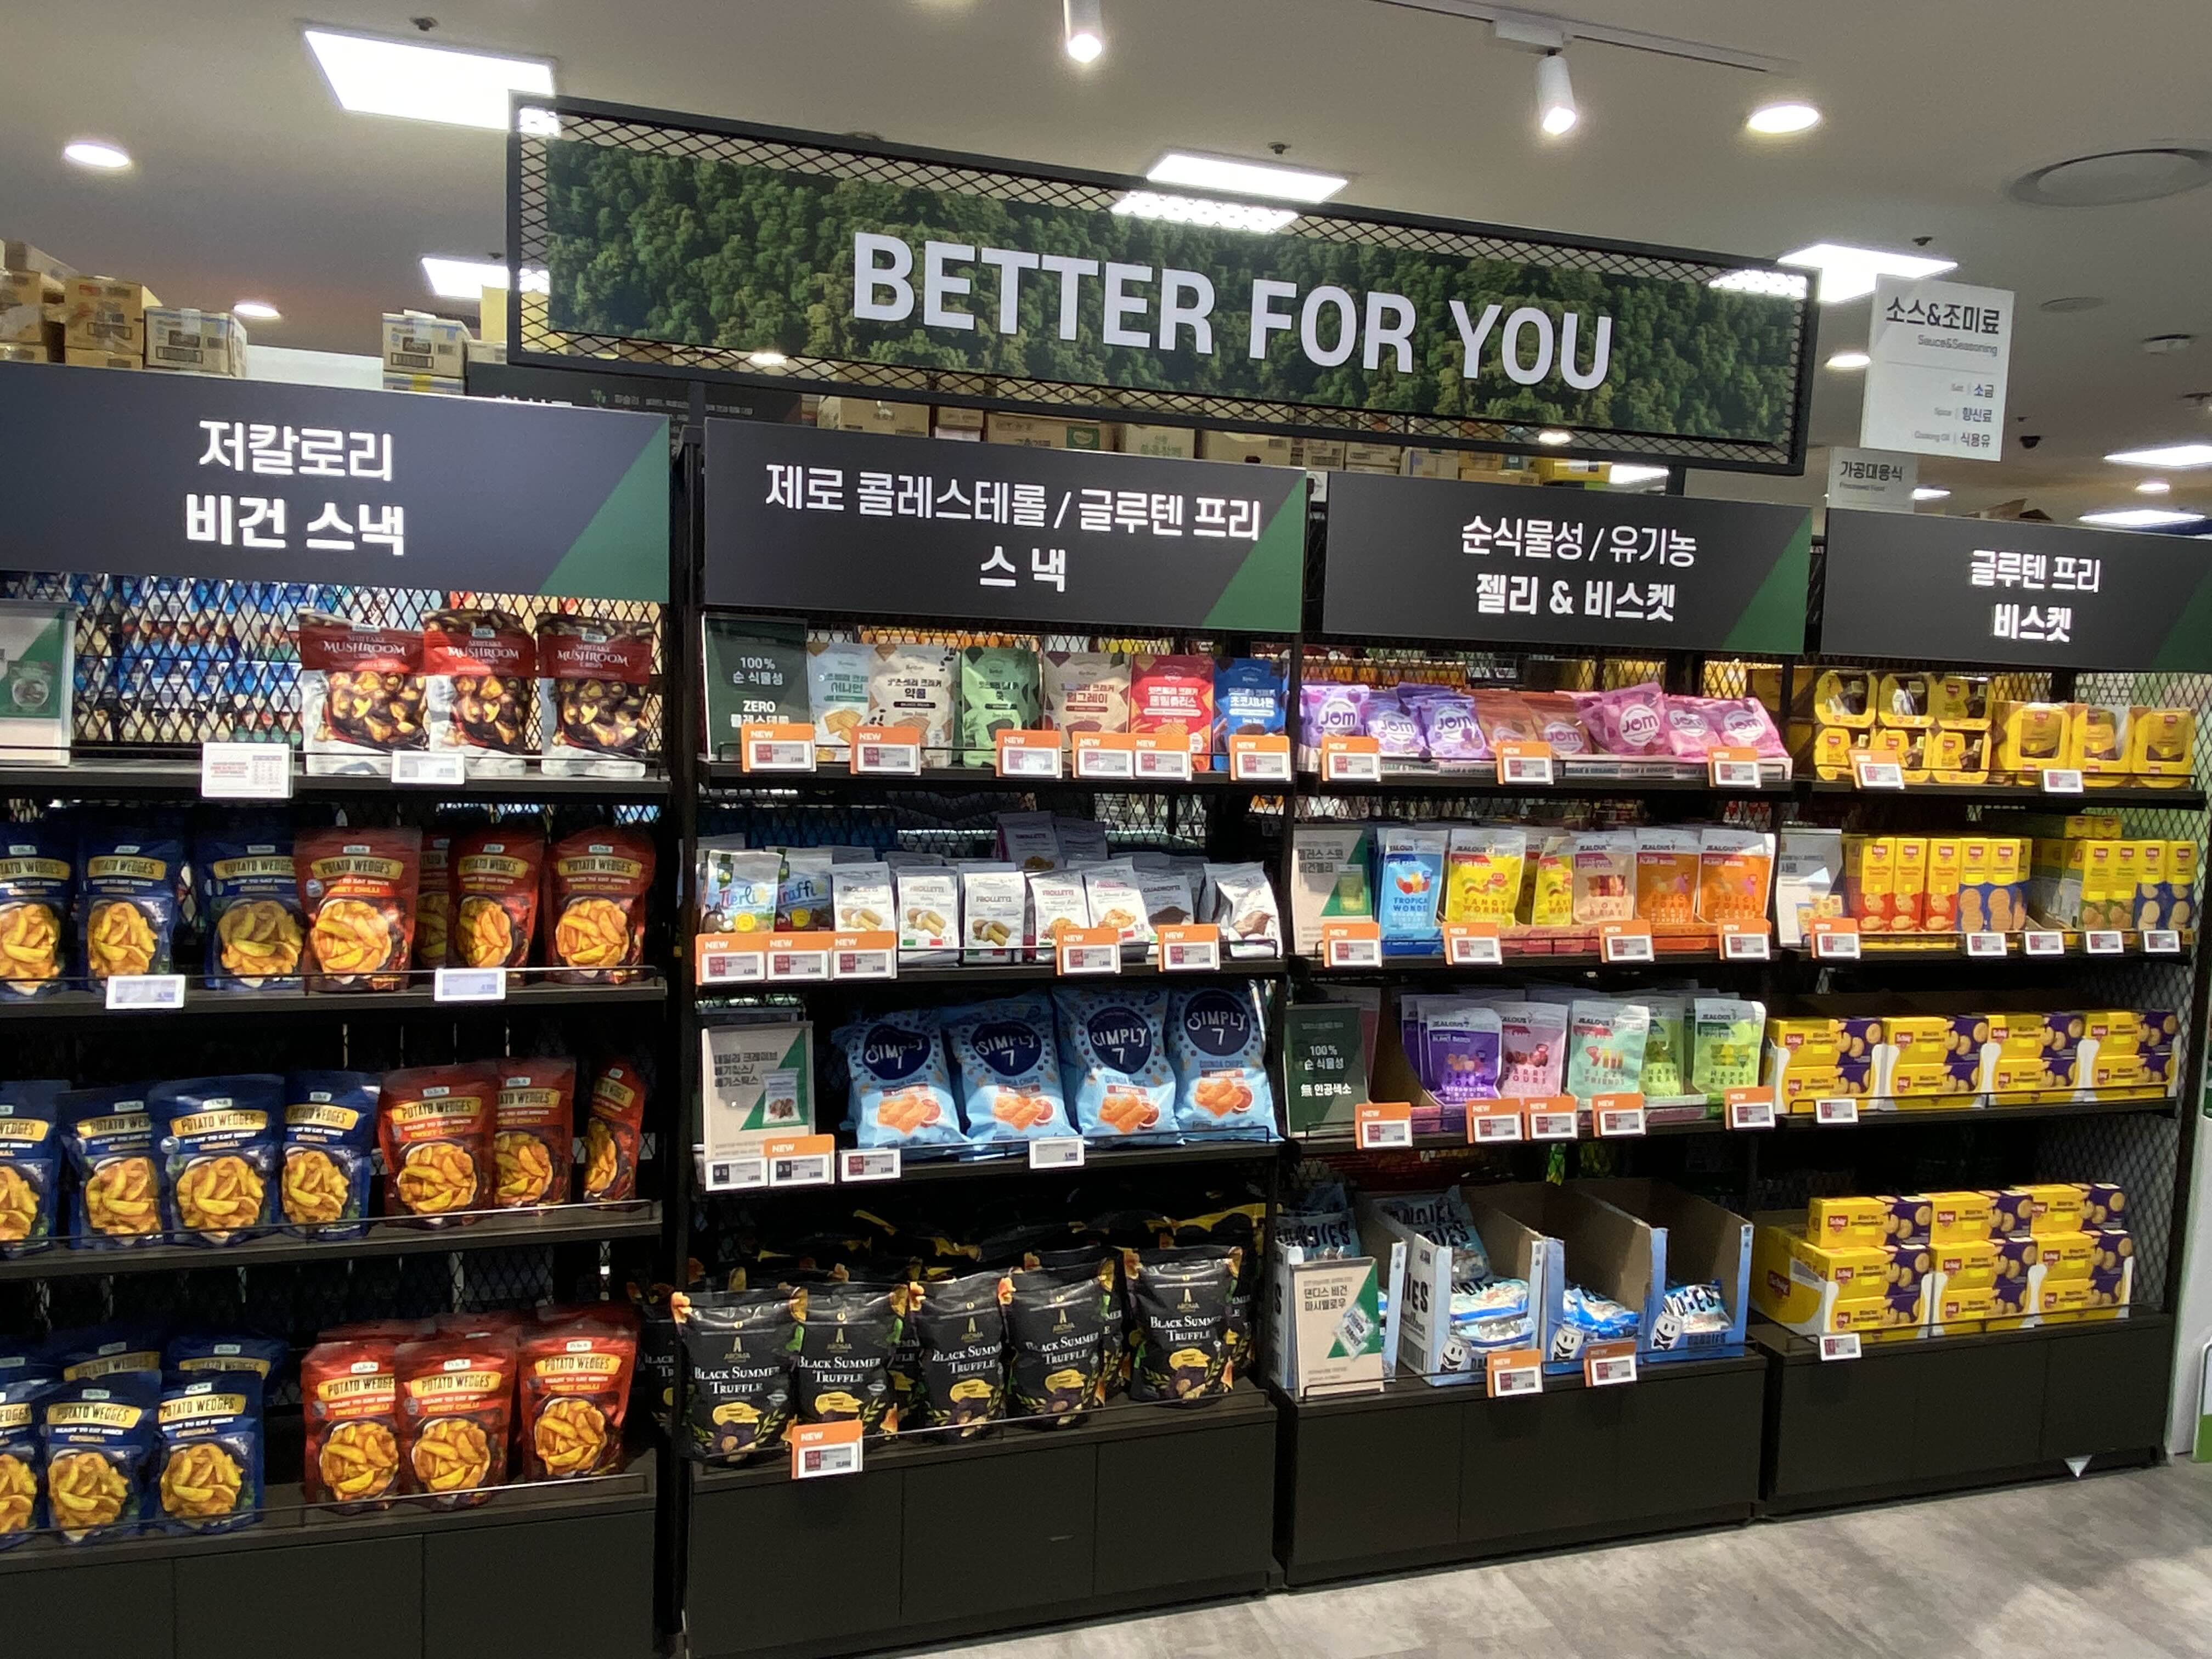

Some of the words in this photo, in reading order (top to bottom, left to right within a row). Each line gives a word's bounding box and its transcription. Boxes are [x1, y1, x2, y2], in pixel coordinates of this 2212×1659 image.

[854, 232, 1216, 354] BETTER
[1248, 278, 1417, 374] FOR
[1449, 300, 1612, 391] YOU
[1886, 296, 2000, 335] 소스&조미료
[1917, 334, 1998, 357] Sauce&Seasoning
[1974, 383, 1994, 398] 소금
[1962, 407, 1993, 422] 향신료
[1961, 432, 1990, 448] 식용유
[199, 420, 393, 482] 저칼로리
[1839, 460, 1903, 481] 가공대용식
[765, 463, 844, 512] 제로
[856, 470, 1046, 529] 콜레스테롤
[1077, 488, 1183, 538] 글루텐
[1193, 496, 1261, 541] 프리
[186, 494, 286, 549] 비건
[306, 503, 405, 556] 스낵
[1461, 515, 1584, 561] 순식물성
[1609, 524, 1697, 568] 유기농
[1971, 550, 2046, 590] 글루텐
[2051, 556, 2101, 594] 프리
[1475, 572, 1539, 616] 젤리
[1549, 580, 1573, 615] &
[1584, 580, 1676, 623] 비스켓
[1993, 603, 2072, 643] 비스켓
[324, 640, 406, 656] MUSHROOM
[447, 646, 520, 660] MUSHROOM
[557, 649, 629, 667] MUSHROOM
[740, 657, 776, 670] 100%
[748, 672, 783, 686] 식물성
[743, 700, 776, 713] ZERO
[859, 732, 882, 741] NEW
[1003, 736, 1025, 744] NEW
[1079, 737, 1102, 747] NEW
[1136, 739, 1158, 748] NEW
[120, 860, 155, 875] WEDGES
[224, 860, 259, 873] POTATO
[320, 860, 351, 874] POTATO
[354, 860, 391, 876] WEDGES
[464, 859, 486, 872] POTATO
[488, 859, 518, 874] WEDGES
[567, 862, 595, 875] POTATO
[598, 861, 631, 876] WEDGES
[354, 885, 380, 894] CHILLI
[704, 940, 729, 950] NEW
[769, 939, 793, 947] NEW
[834, 938, 857, 947] NEW
[1063, 934, 1084, 942] NEW
[1187, 1011, 1246, 1031] SIMPLY
[1091, 1027, 1148, 1048] SIMPLY
[1211, 1028, 1224, 1045] 7
[975, 1034, 1035, 1056] SIMPLY
[1309, 1045, 1338, 1056] 100%
[1001, 1049, 1014, 1067] 7
[1111, 1047, 1124, 1064] 7
[1317, 1057, 1344, 1070] 식물성
[1314, 1083, 1352, 1096] 인공색소
[518, 1091, 551, 1104] WEDGES
[316, 1106, 347, 1124] WEDGES
[402, 1103, 433, 1119] POTATO
[436, 1100, 471, 1114] WEDGES
[1362, 1110, 1380, 1118] NEW
[91, 1118, 125, 1132] POTATO
[181, 1116, 216, 1131] POTATO
[219, 1113, 256, 1127] WEDGES
[772, 1143, 795, 1153] NEW
[1304, 1288, 1329, 1299] 댄디스
[1331, 1285, 1347, 1296] 비건
[1150, 1316, 1182, 1329] BLACK
[1061, 1331, 1099, 1349] SUMMER
[1165, 1329, 1211, 1342] TRUFFLE
[933, 1348, 966, 1362] BLACK
[1043, 1348, 1089, 1365] TRUFFLE
[545, 1356, 575, 1372] POTATO
[578, 1356, 610, 1371] WEDGES
[797, 1356, 832, 1370] BLACK
[948, 1359, 995, 1374] TRUFFLE
[694, 1366, 729, 1380] BLACK
[812, 1369, 863, 1384] TRUFFLE
[328, 1380, 362, 1396] POTATO
[364, 1376, 395, 1390] WEDGE
[421, 1376, 453, 1392] POTATO
[456, 1373, 490, 1389] WEDGES
[710, 1381, 763, 1394] TRUFFLE
[162, 1402, 193, 1417] POTATO
[197, 1396, 235, 1412] WEDGES
[57, 1406, 89, 1419] POTATO
[92, 1406, 129, 1423] WEDGES
[800, 1432, 823, 1441] NEW
